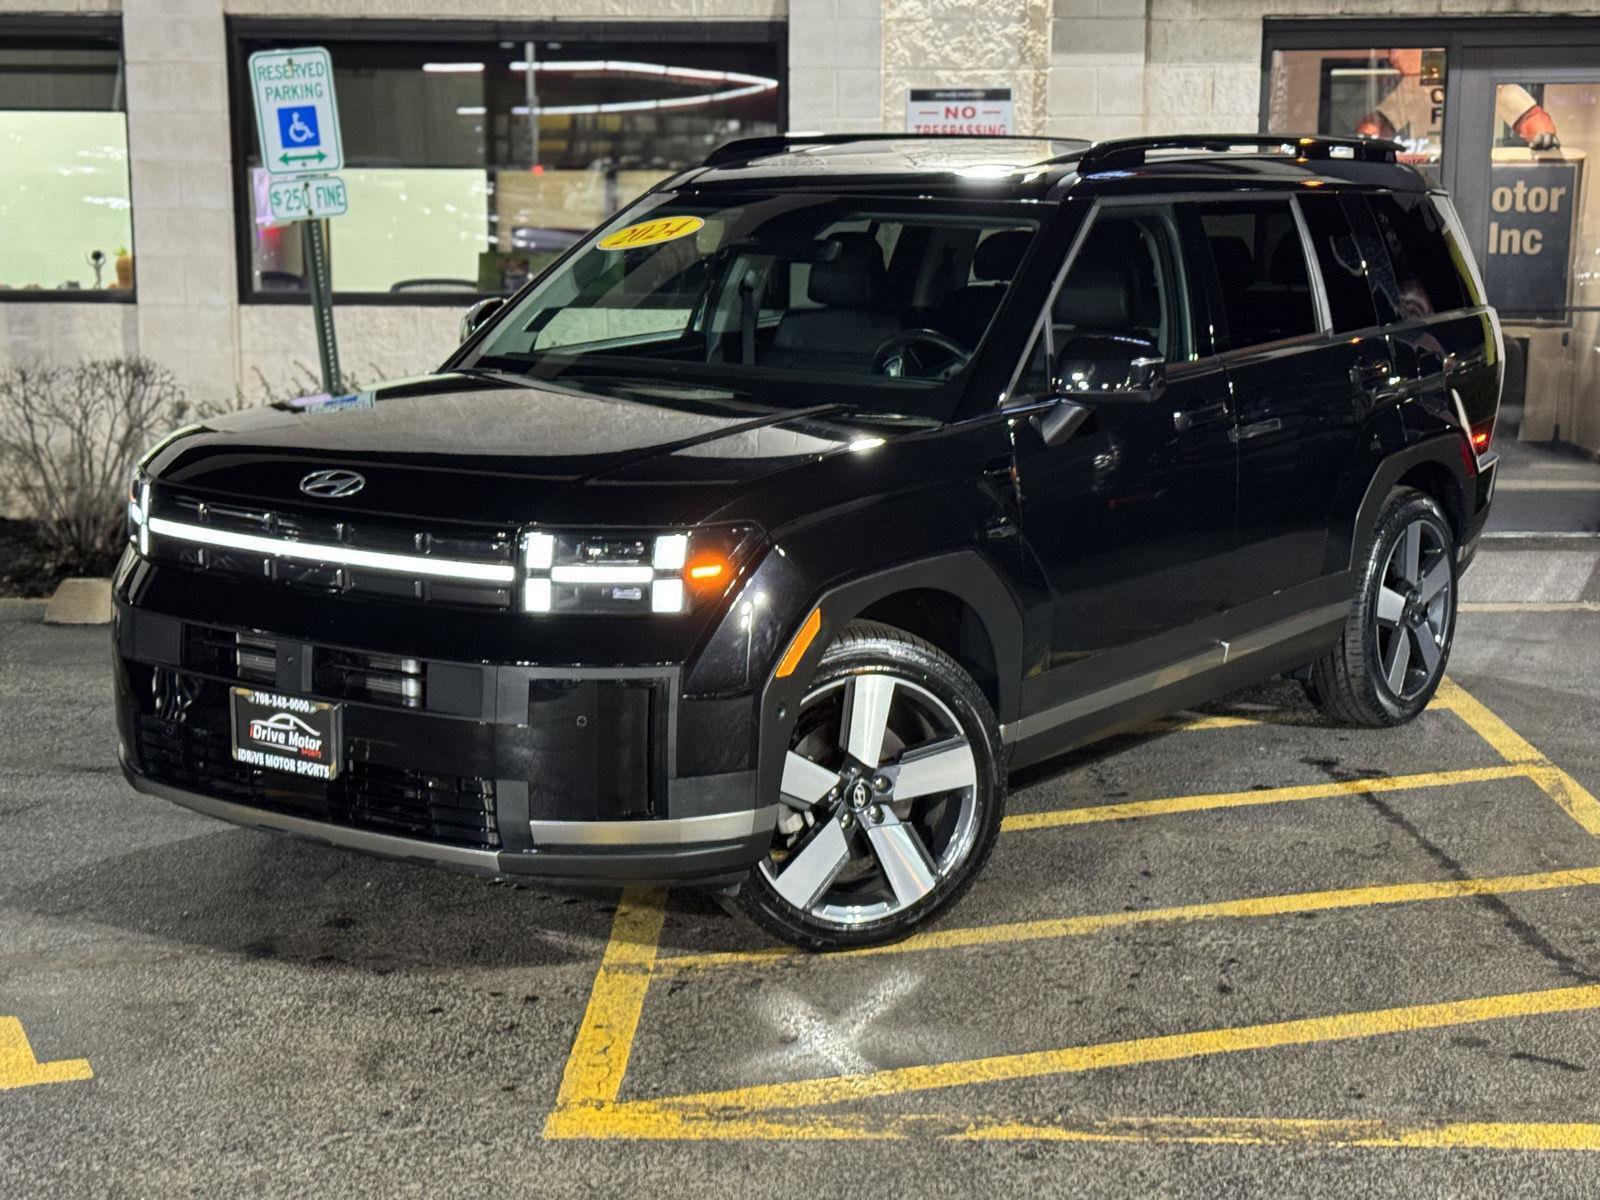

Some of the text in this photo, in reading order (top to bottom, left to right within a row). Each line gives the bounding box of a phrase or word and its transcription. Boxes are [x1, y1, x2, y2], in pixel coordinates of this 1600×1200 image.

[257, 62, 325, 81] RESERVED
[265, 83, 324, 102] PARKING
[944, 106, 976, 119] NO
[271, 184, 346, 211] $250 FINE
[609, 219, 694, 247] 2024
[1488, 222, 1543, 255] Inc
[288, 730, 322, 751] Motor
[265, 753, 296, 773] MOTOR
[296, 760, 330, 779] SPORTS
